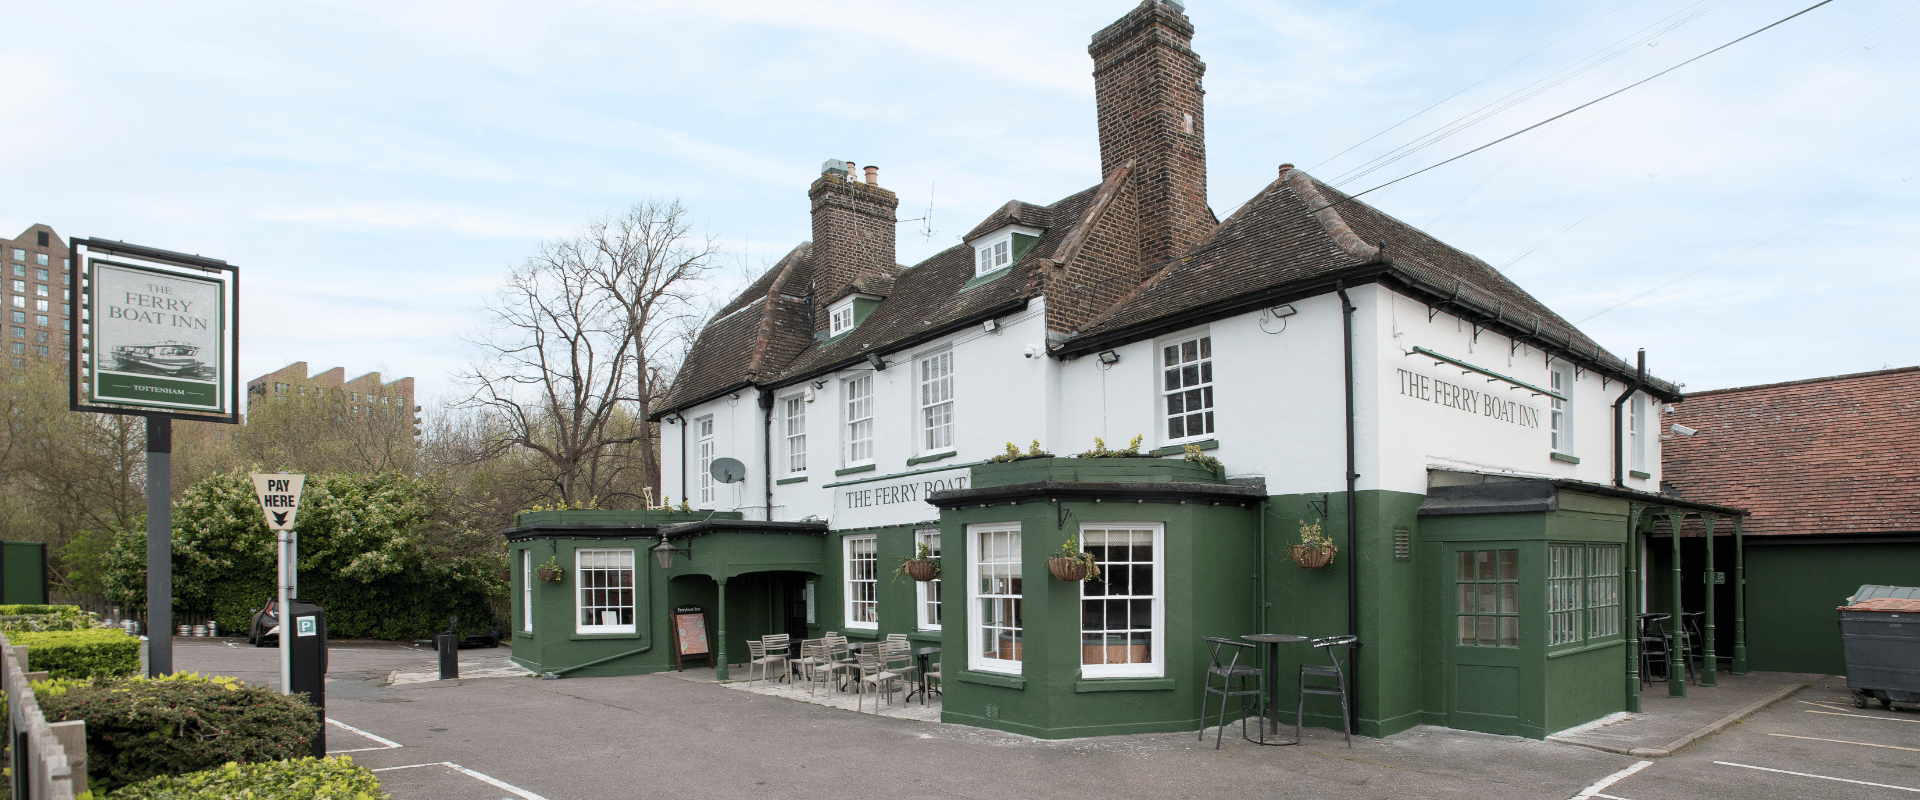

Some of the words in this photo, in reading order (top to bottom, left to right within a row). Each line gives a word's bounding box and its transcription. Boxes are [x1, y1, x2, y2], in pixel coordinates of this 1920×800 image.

[147, 284, 173, 295] THE
[125, 292, 193, 313] FERRY
[109, 305, 166, 325] BOAT
[172, 314, 207, 331] INN
[133, 384, 185, 396] TOTTENHAM
[1397, 368, 1431, 402] THE
[1433, 378, 1480, 414] FERRY
[1483, 393, 1516, 424] BOAT
[1518, 404, 1540, 430] INN
[267, 479, 290, 492] PAY
[264, 494, 296, 507] HERE
[845, 489, 872, 509] THE
[875, 482, 920, 506] FERRY
